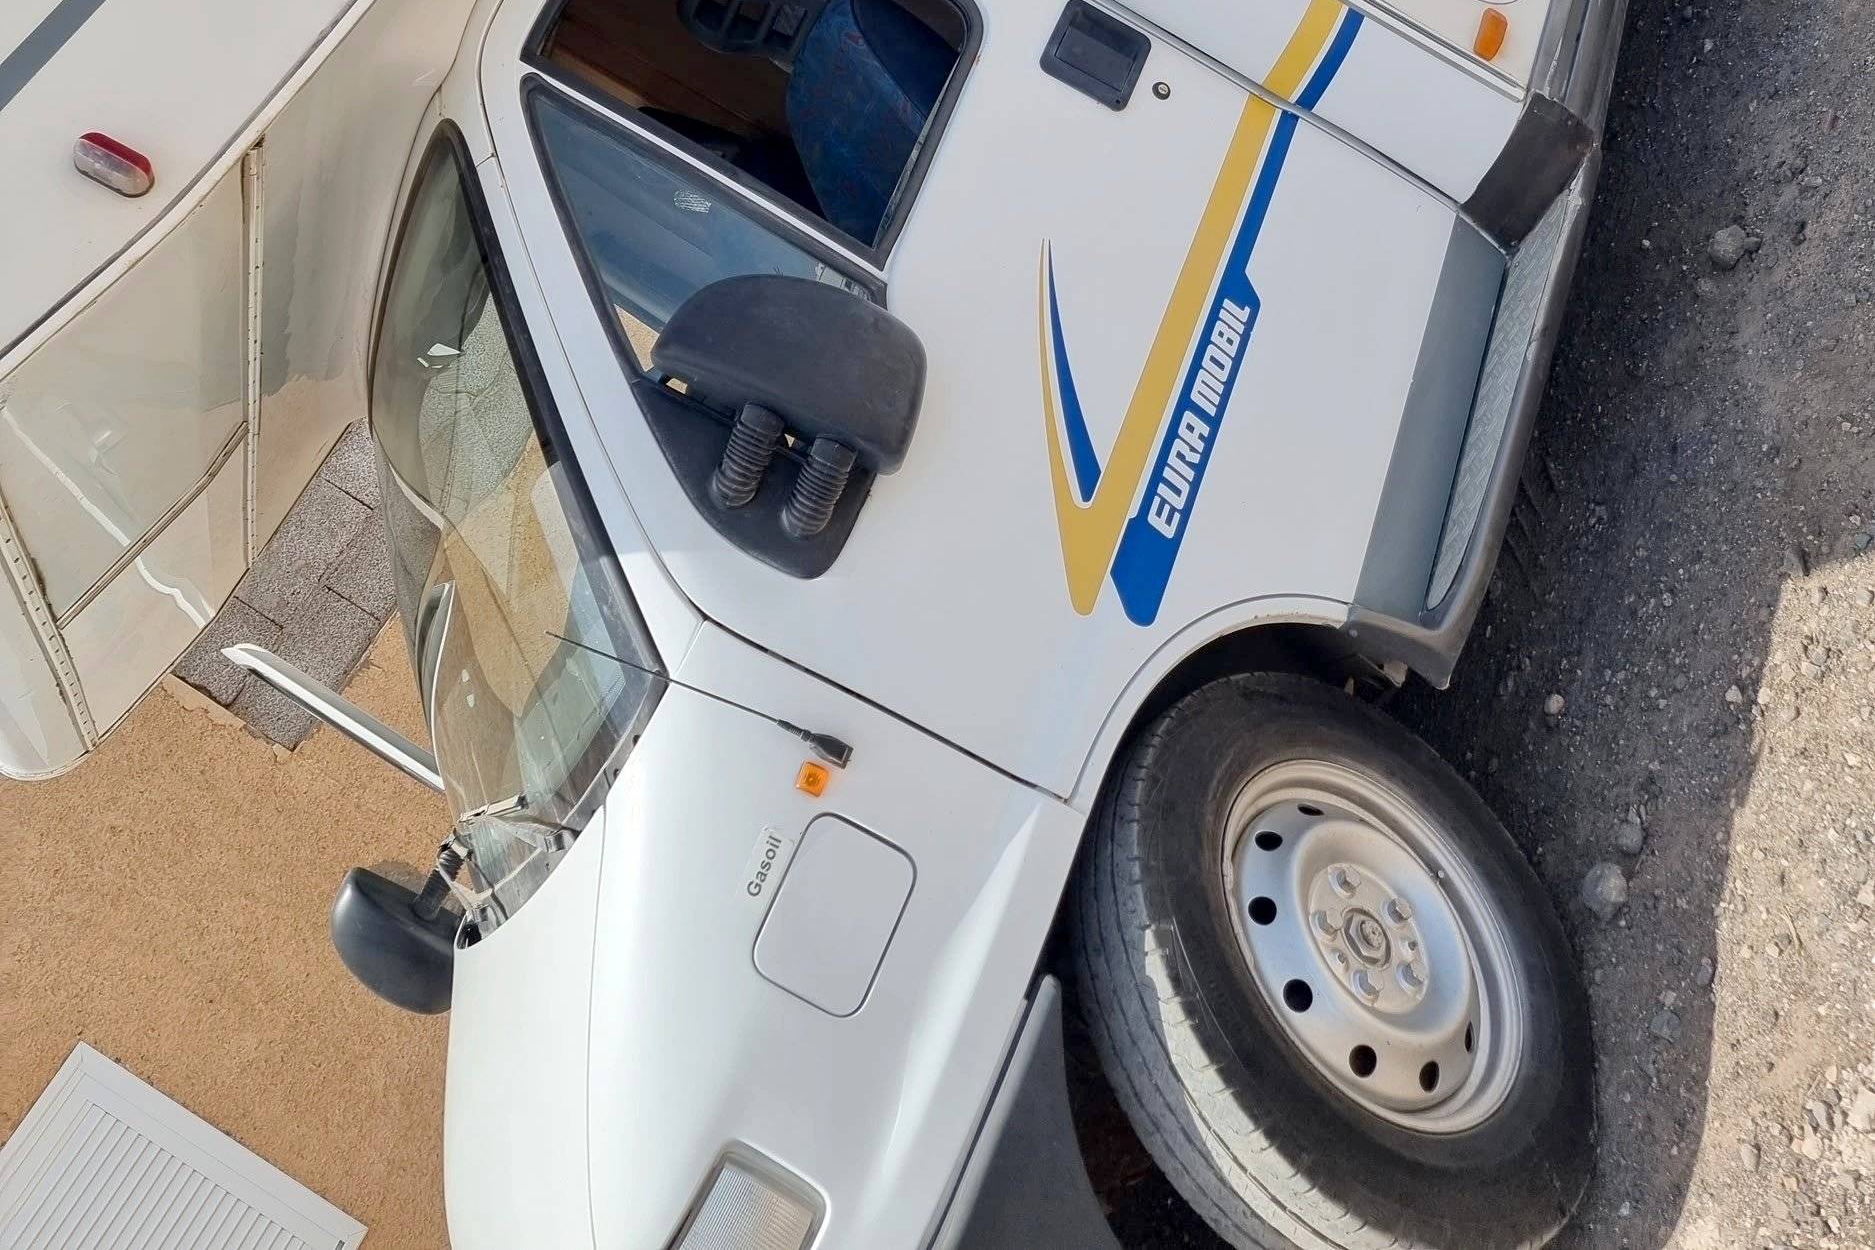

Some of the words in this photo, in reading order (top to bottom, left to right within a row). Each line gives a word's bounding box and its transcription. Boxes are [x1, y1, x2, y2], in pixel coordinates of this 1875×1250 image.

[1147, 410, 1210, 538] EURA
[1190, 298, 1250, 417] MOBIL
[746, 834, 782, 897] Gasoil
